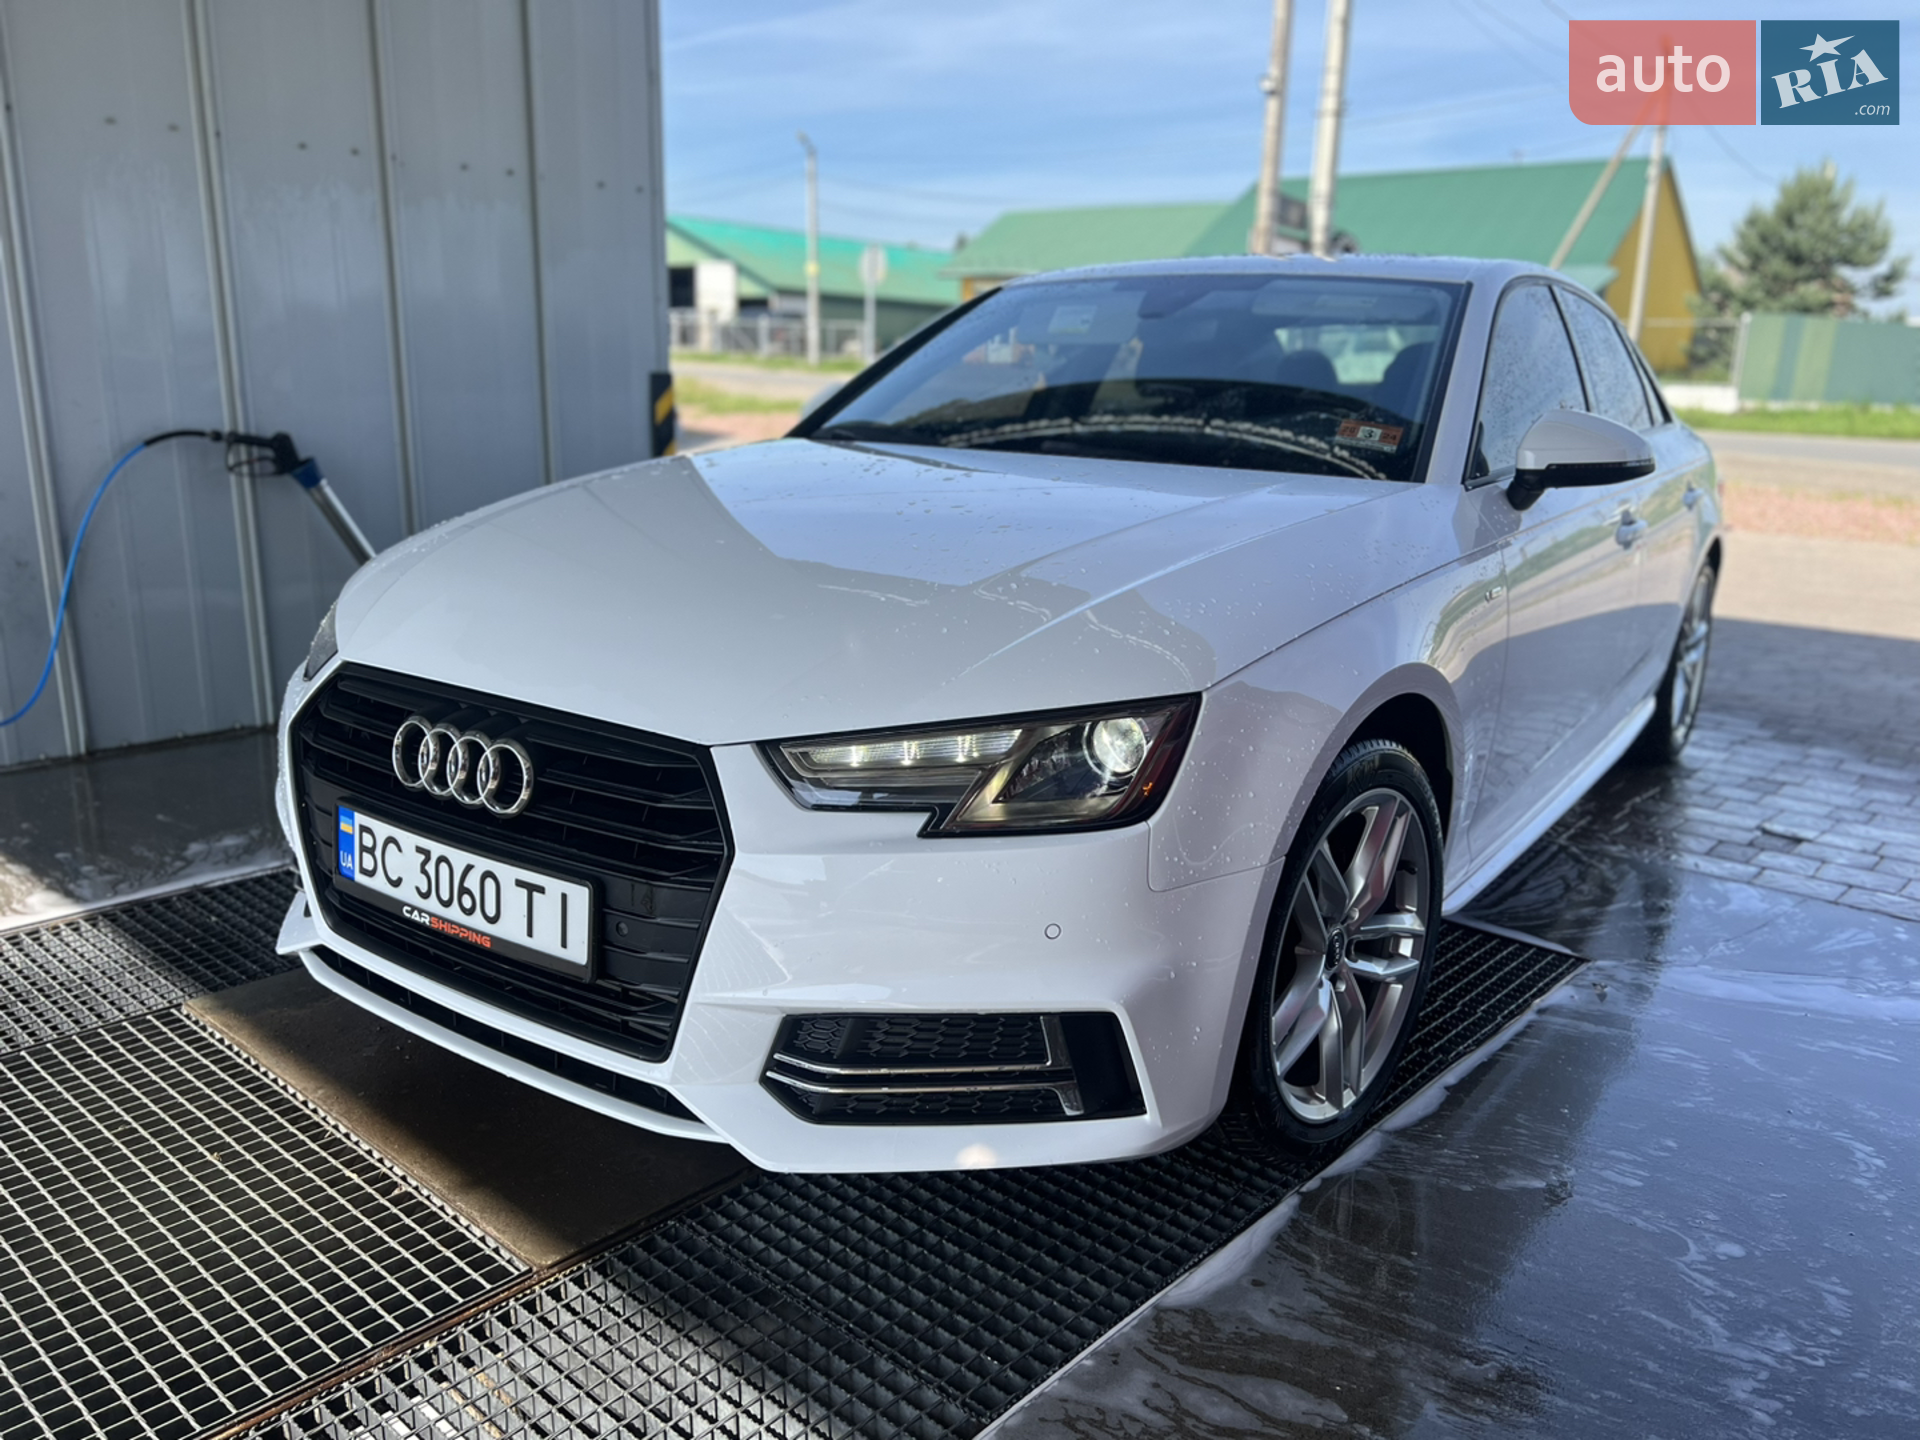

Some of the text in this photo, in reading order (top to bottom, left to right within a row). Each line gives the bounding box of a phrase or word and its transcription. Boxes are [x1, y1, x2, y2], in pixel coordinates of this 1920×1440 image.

[1364, 428, 1375, 439] 3
[339, 850, 354, 870] UA
[358, 824, 568, 949] BC 3060 TI
[402, 905, 491, 948] CARSHIPPING
